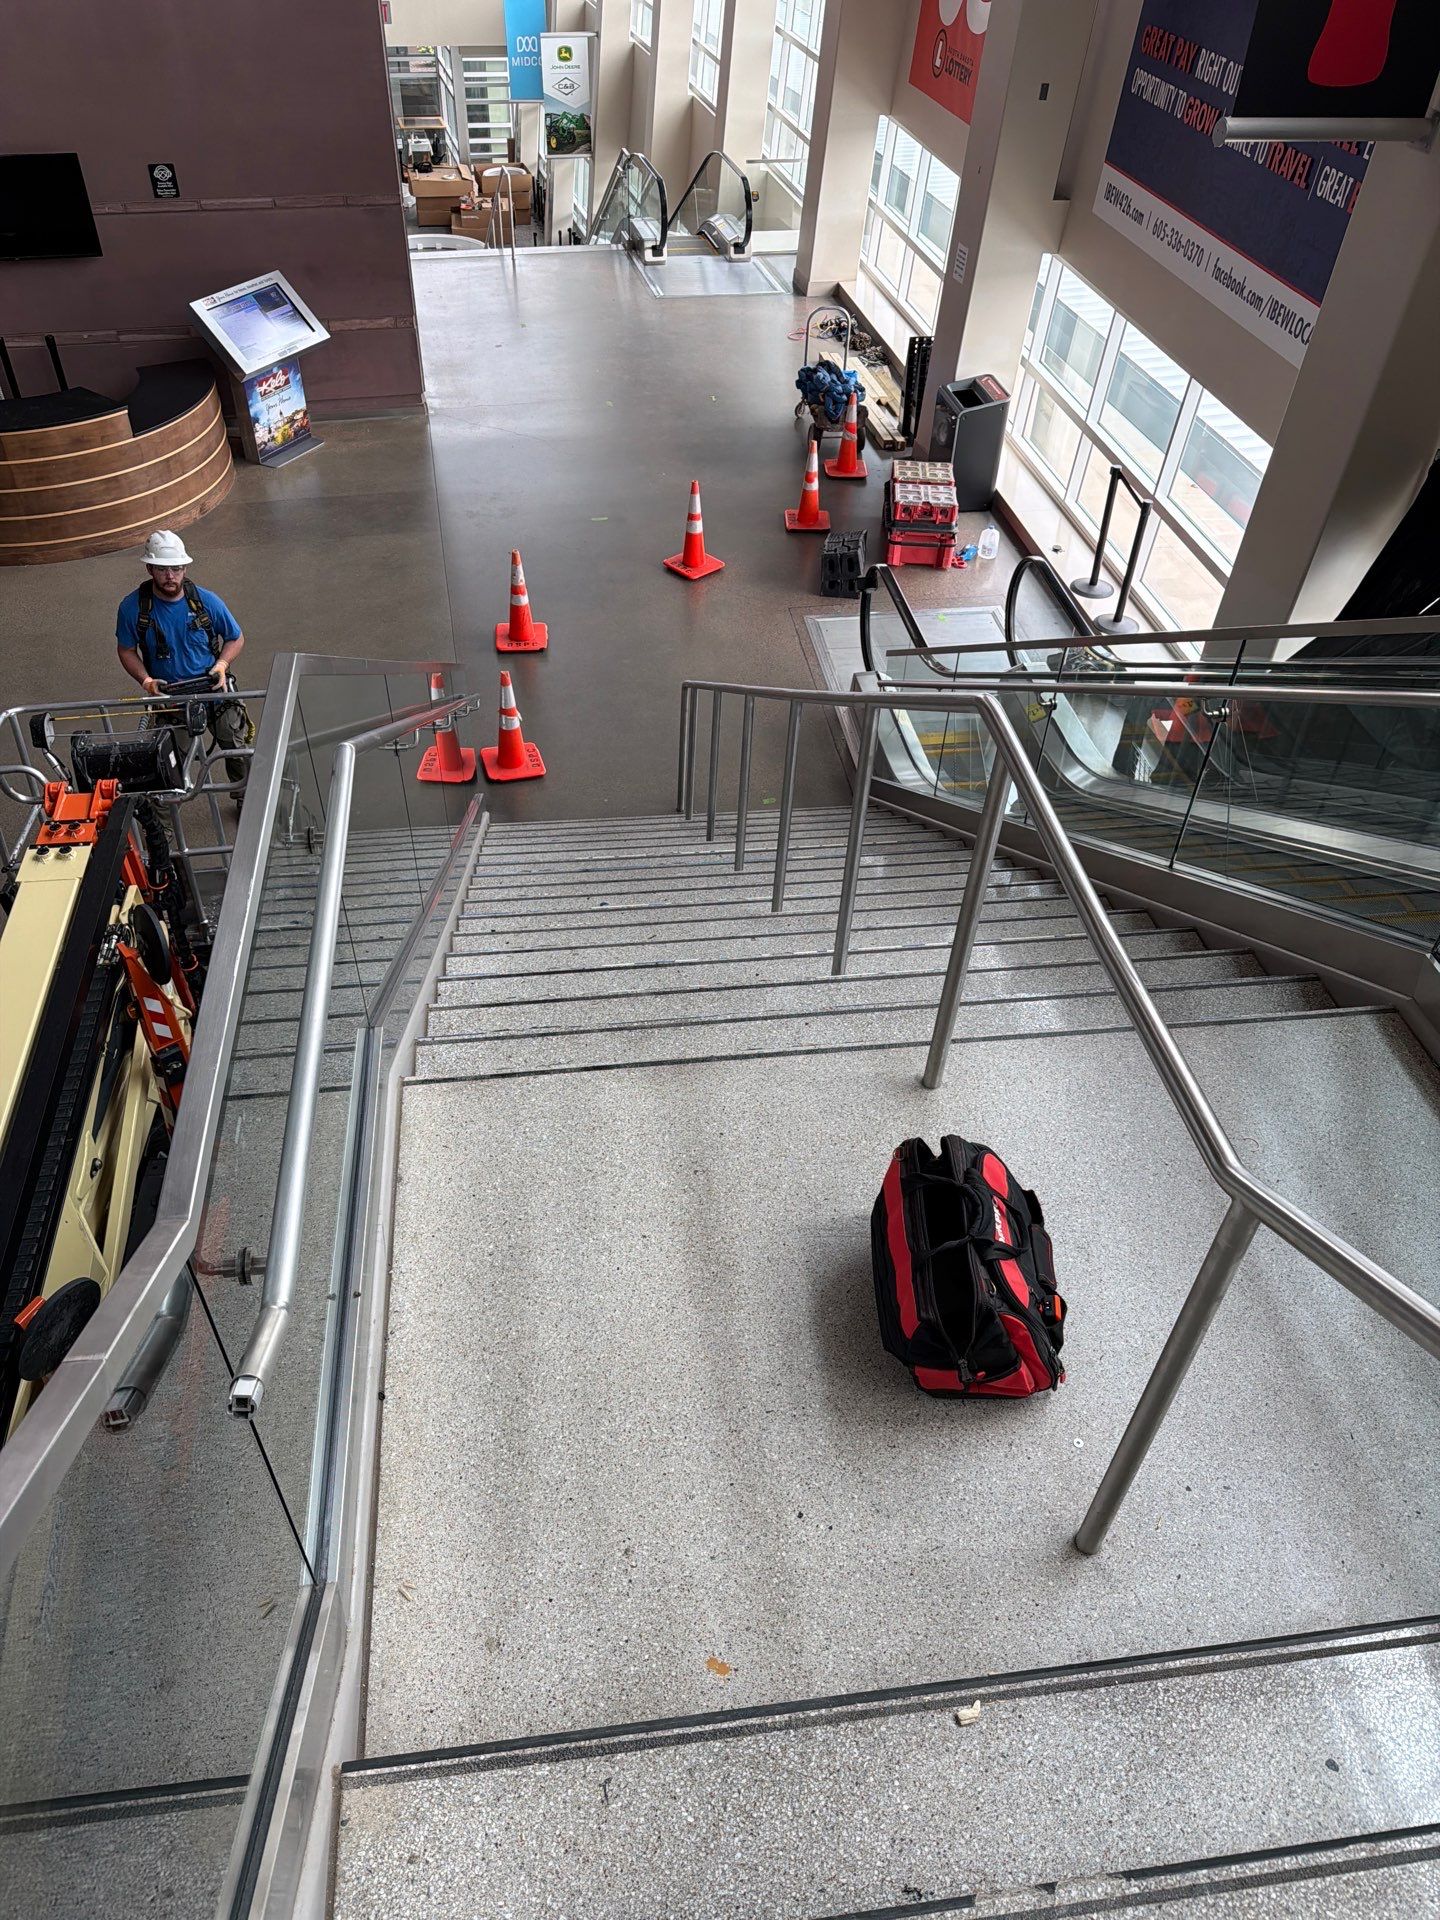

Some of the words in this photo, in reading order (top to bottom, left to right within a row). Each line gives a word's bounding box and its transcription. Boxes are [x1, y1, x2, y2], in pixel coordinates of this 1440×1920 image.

[944, 55, 972, 86] LOTTERY
[1141, 25, 1176, 65] GREAT
[1172, 37, 1199, 75] PAY
[1195, 48, 1226, 87] RIGHT
[1131, 67, 1178, 113] OPPORTUNITY
[1173, 89, 1187, 119] TO
[1183, 96, 1220, 137] GROW
[1265, 142, 1312, 189] TRAVEL
[1317, 165, 1354, 209] GREAT
[1104, 181, 1145, 226] IBEW426.com
[1152, 217, 1204, 268] 605-336-0370
